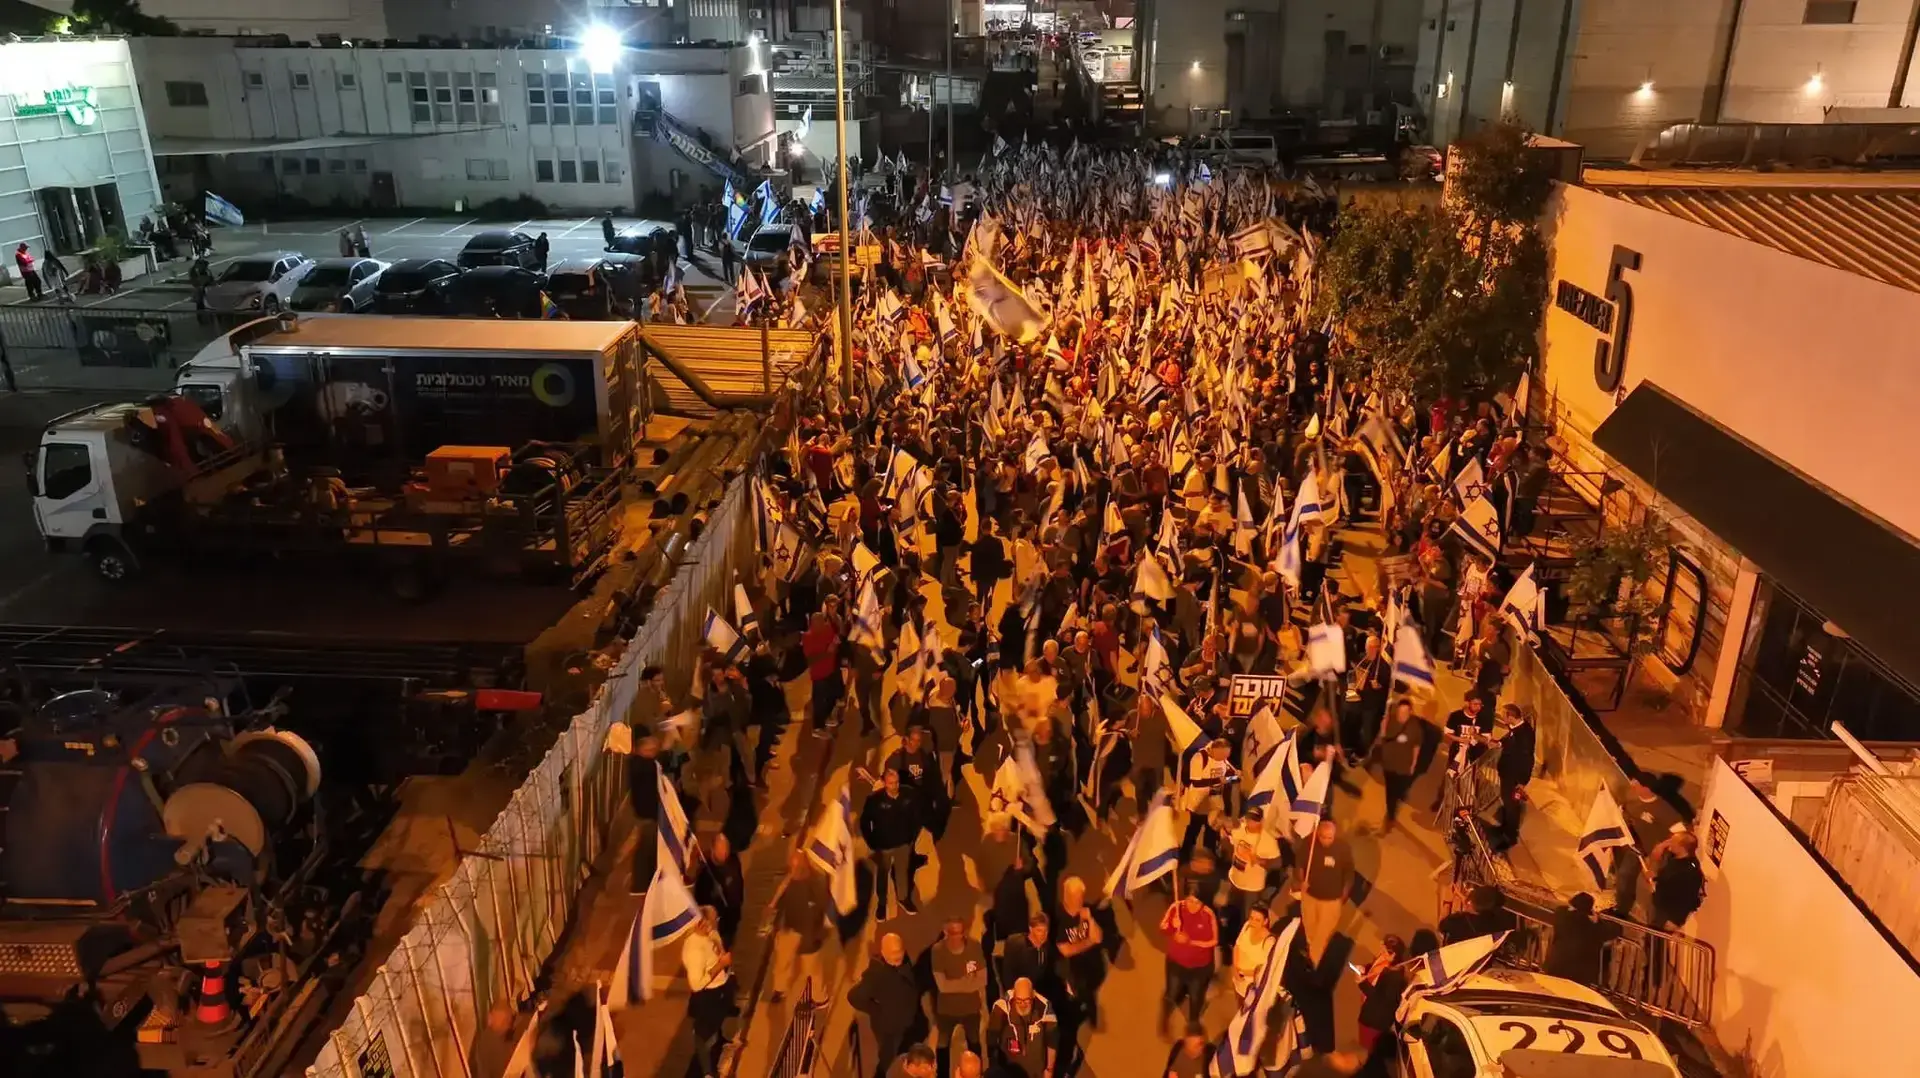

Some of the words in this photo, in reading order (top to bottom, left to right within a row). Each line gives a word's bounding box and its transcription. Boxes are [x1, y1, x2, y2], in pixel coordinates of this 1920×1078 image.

[1594, 244, 1644, 393] 5
[416, 372, 486, 387] טכנולוגיות
[490, 375, 530, 388] מאירי
[1234, 679, 1284, 697] חובה
[1499, 1021, 1643, 1061] 229
